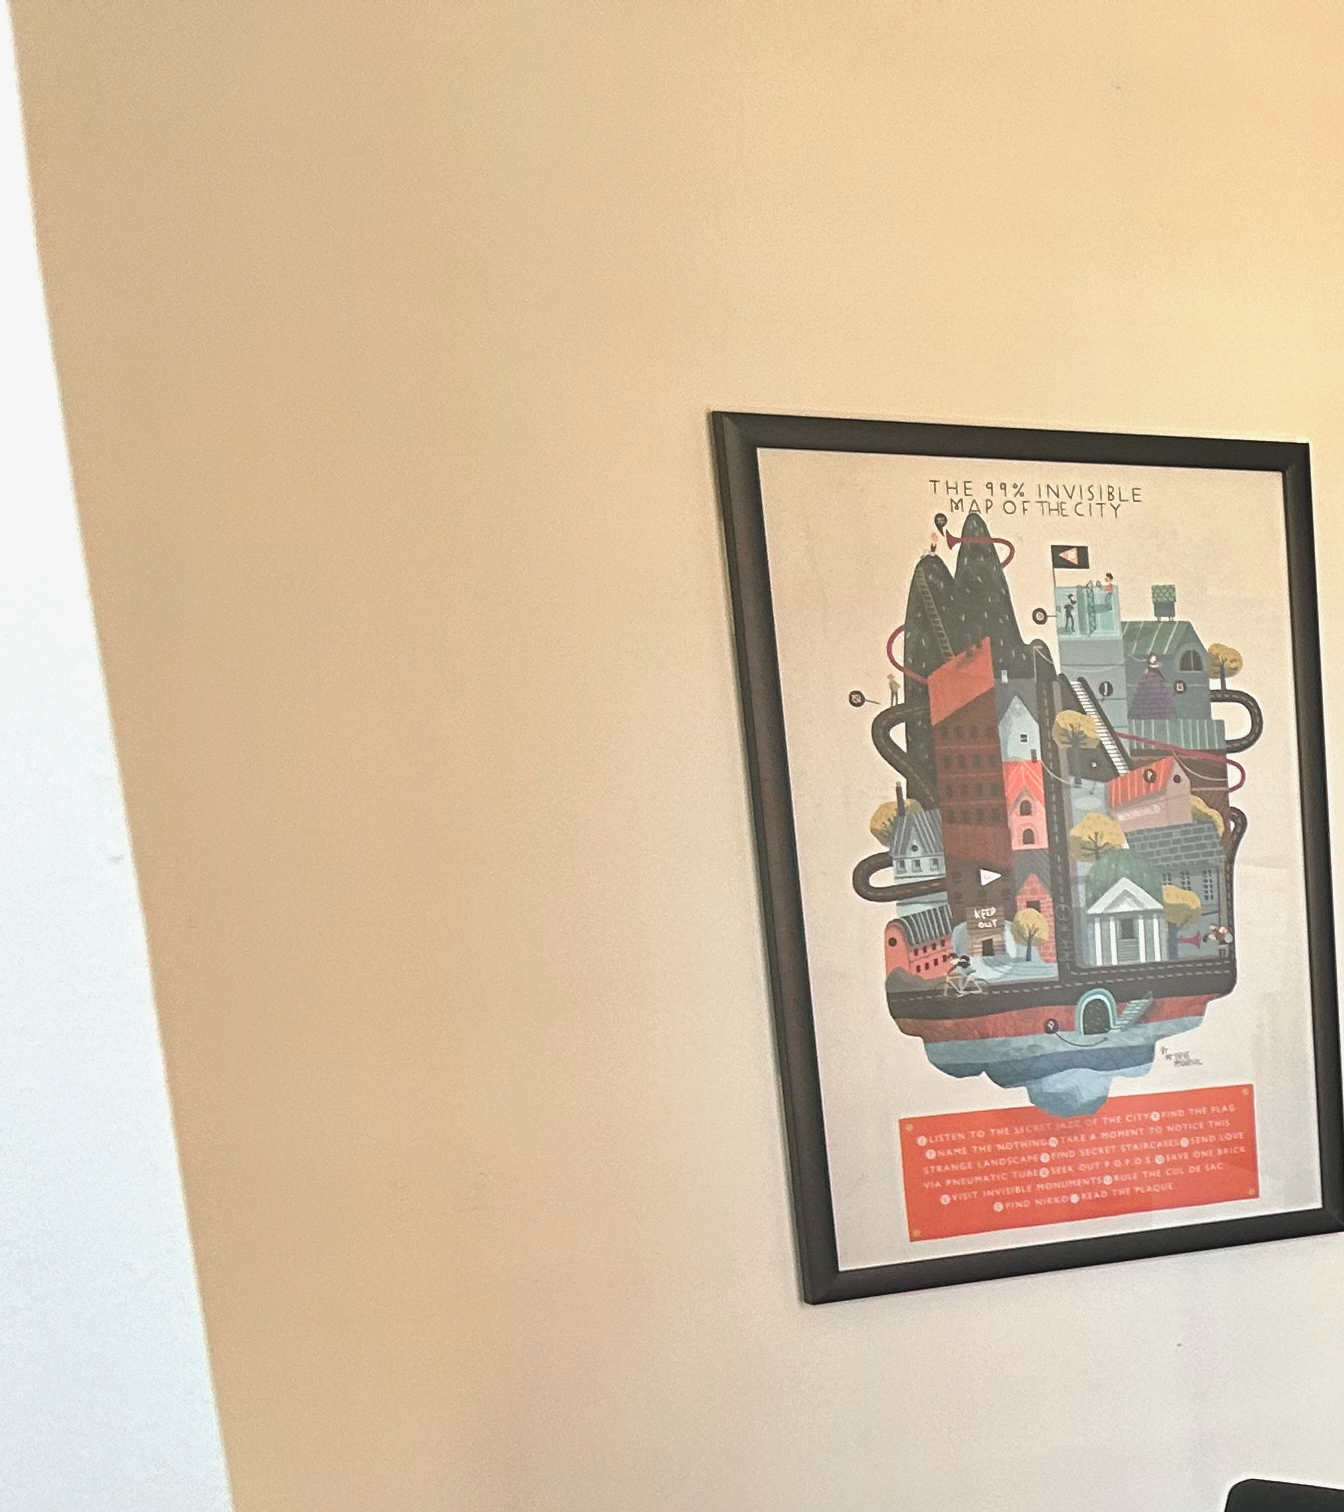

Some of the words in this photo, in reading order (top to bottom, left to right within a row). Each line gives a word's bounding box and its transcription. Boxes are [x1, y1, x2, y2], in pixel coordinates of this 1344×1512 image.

[929, 480, 973, 496] THE
[985, 482, 1024, 497] 99%
[1038, 484, 1142, 502] INVISIBLE
[951, 498, 993, 513] MAP
[1003, 500, 1030, 515] OF
[1037, 501, 1068, 516] THE
[1074, 502, 1121, 518] CITY
[928, 1132, 965, 1143] LISTEN
[970, 1130, 984, 1138] TO
[990, 1128, 1009, 1136] THE
[1014, 1124, 1050, 1134] SECRET
[1056, 1120, 1080, 1131] JAZZ
[1085, 1118, 1097, 1126] OF
[1103, 1115, 1121, 1124] THE
[1126, 1113, 1150, 1122] CITY
[1161, 1110, 1184, 1118] FIND
[1211, 1104, 1235, 1112] FLAG
[937, 1148, 968, 1156] NAME
[972, 1144, 992, 1153] THE
[998, 1140, 1048, 1151] NOTHING
[1062, 1134, 1085, 1143] TAKE
[1101, 1129, 1144, 1139] MOMENT
[1167, 1122, 1204, 1132] NOTICE
[1209, 1120, 1230, 1128] THIS
[924, 1163, 973, 1174] STRANGE
[978, 1155, 1039, 1168] LANDSCAPE
[1051, 1151, 1076, 1160] FIND
[1080, 1145, 1116, 1156] SECRET
[1121, 1139, 1179, 1152] STAIRCASES
[1191, 1135, 1216, 1144] SEND
[1220, 1132, 1244, 1141] LOVE
